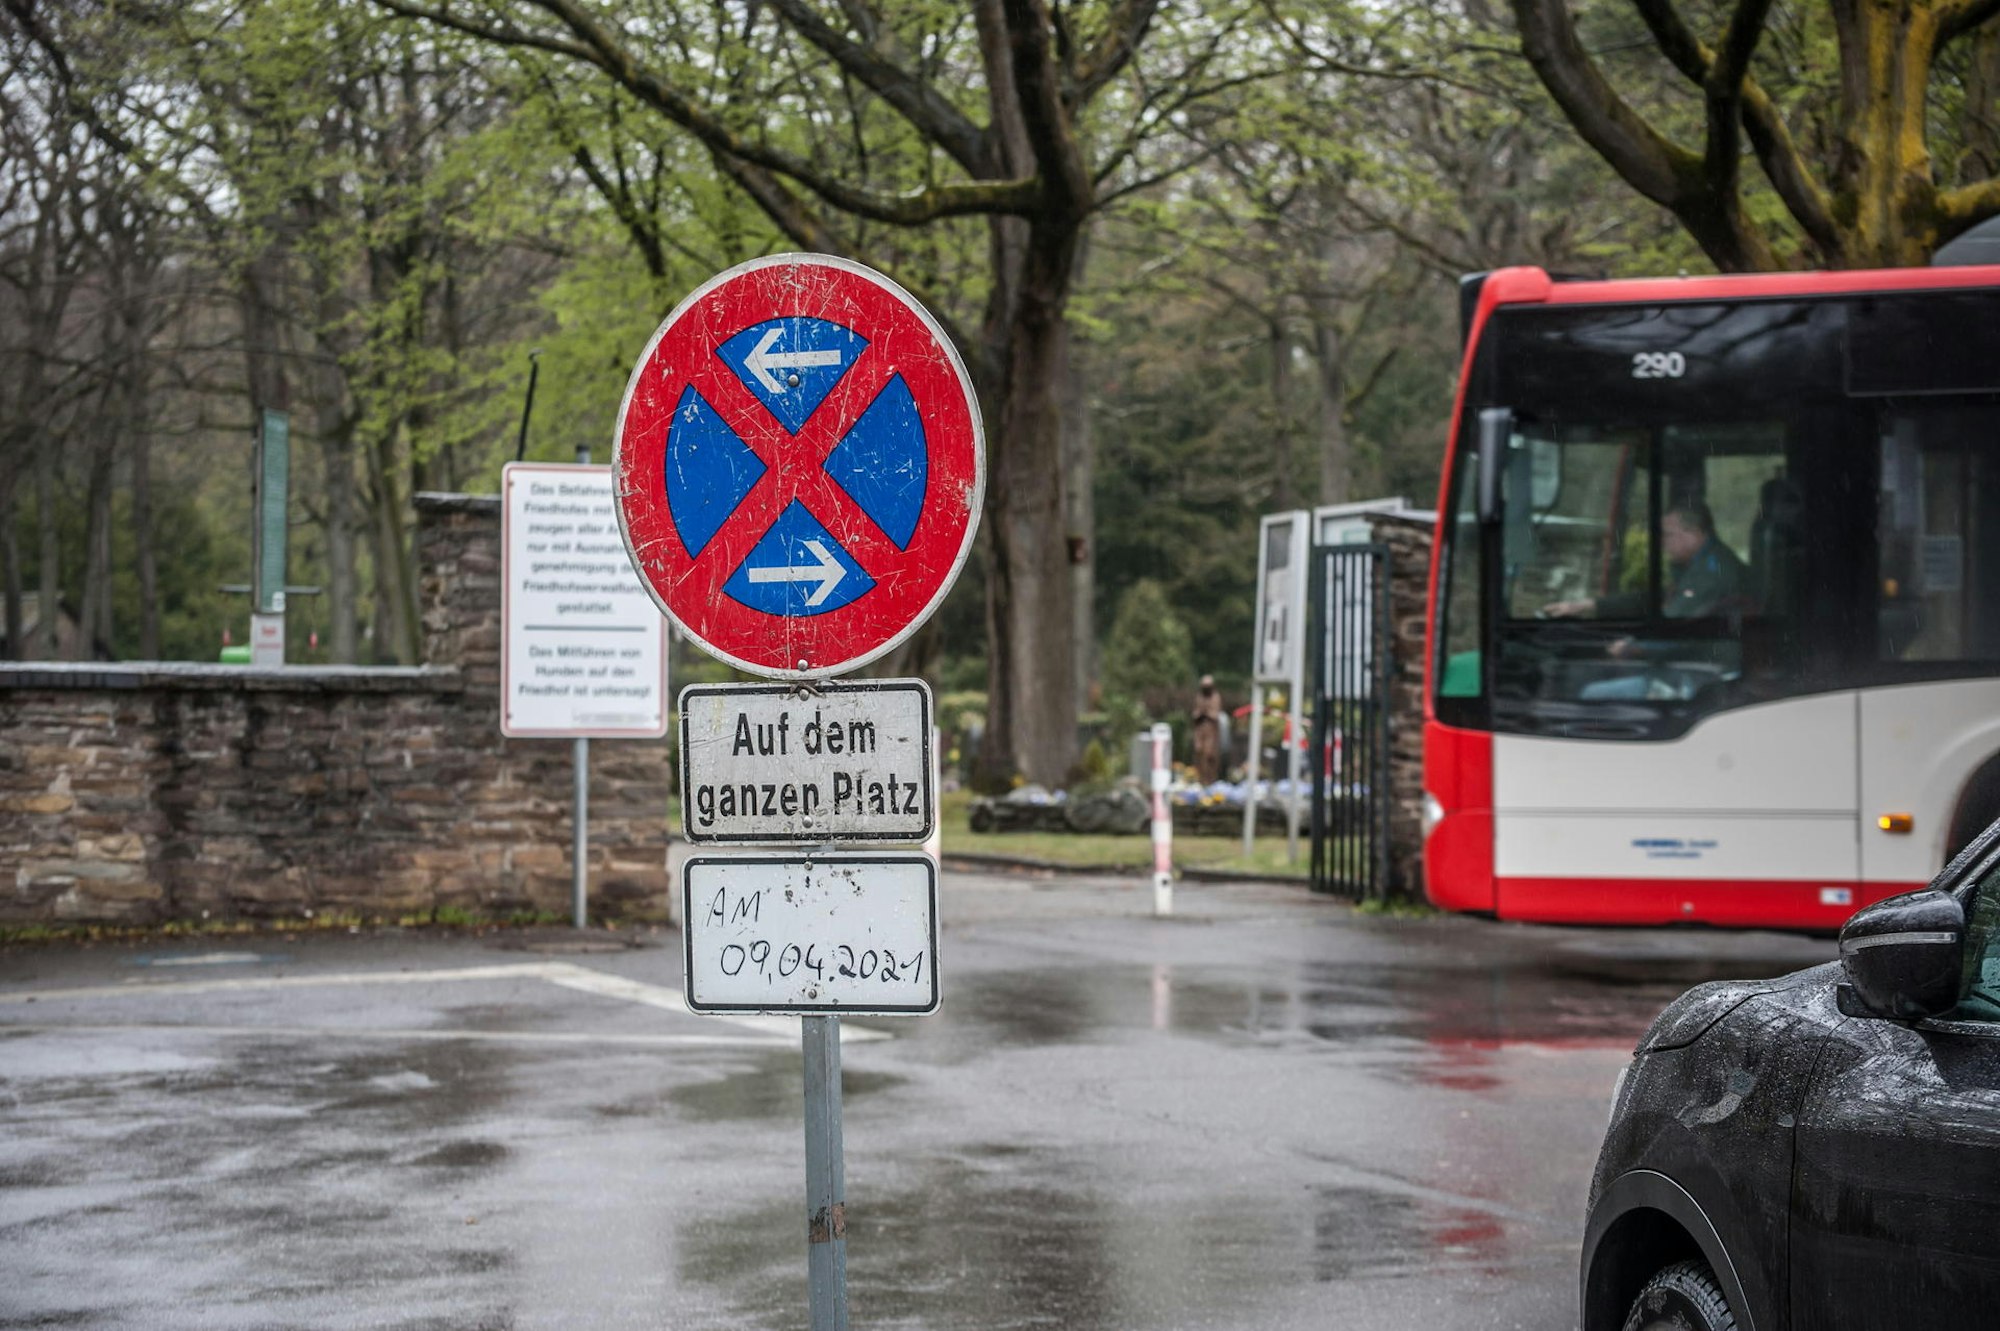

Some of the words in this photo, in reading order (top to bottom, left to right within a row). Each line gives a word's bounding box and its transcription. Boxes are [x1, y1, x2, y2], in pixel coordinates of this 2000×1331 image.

[1632, 352, 1685, 378] 290
[530, 482, 554, 496] Das
[523, 502, 589, 515] Friedhofes
[531, 561, 617, 576] genehmigung
[528, 644, 553, 658] Das
[557, 645, 615, 658] Mitführen
[620, 646, 641, 658] von
[535, 664, 583, 677] Hunden
[588, 665, 607, 677] auf
[518, 682, 570, 696] Friedhof
[573, 683, 587, 696] ist
[732, 711, 789, 756] Auf
[803, 711, 876, 755] dem
[697, 782, 820, 827] ganzen
[833, 771, 919, 815] Platz
